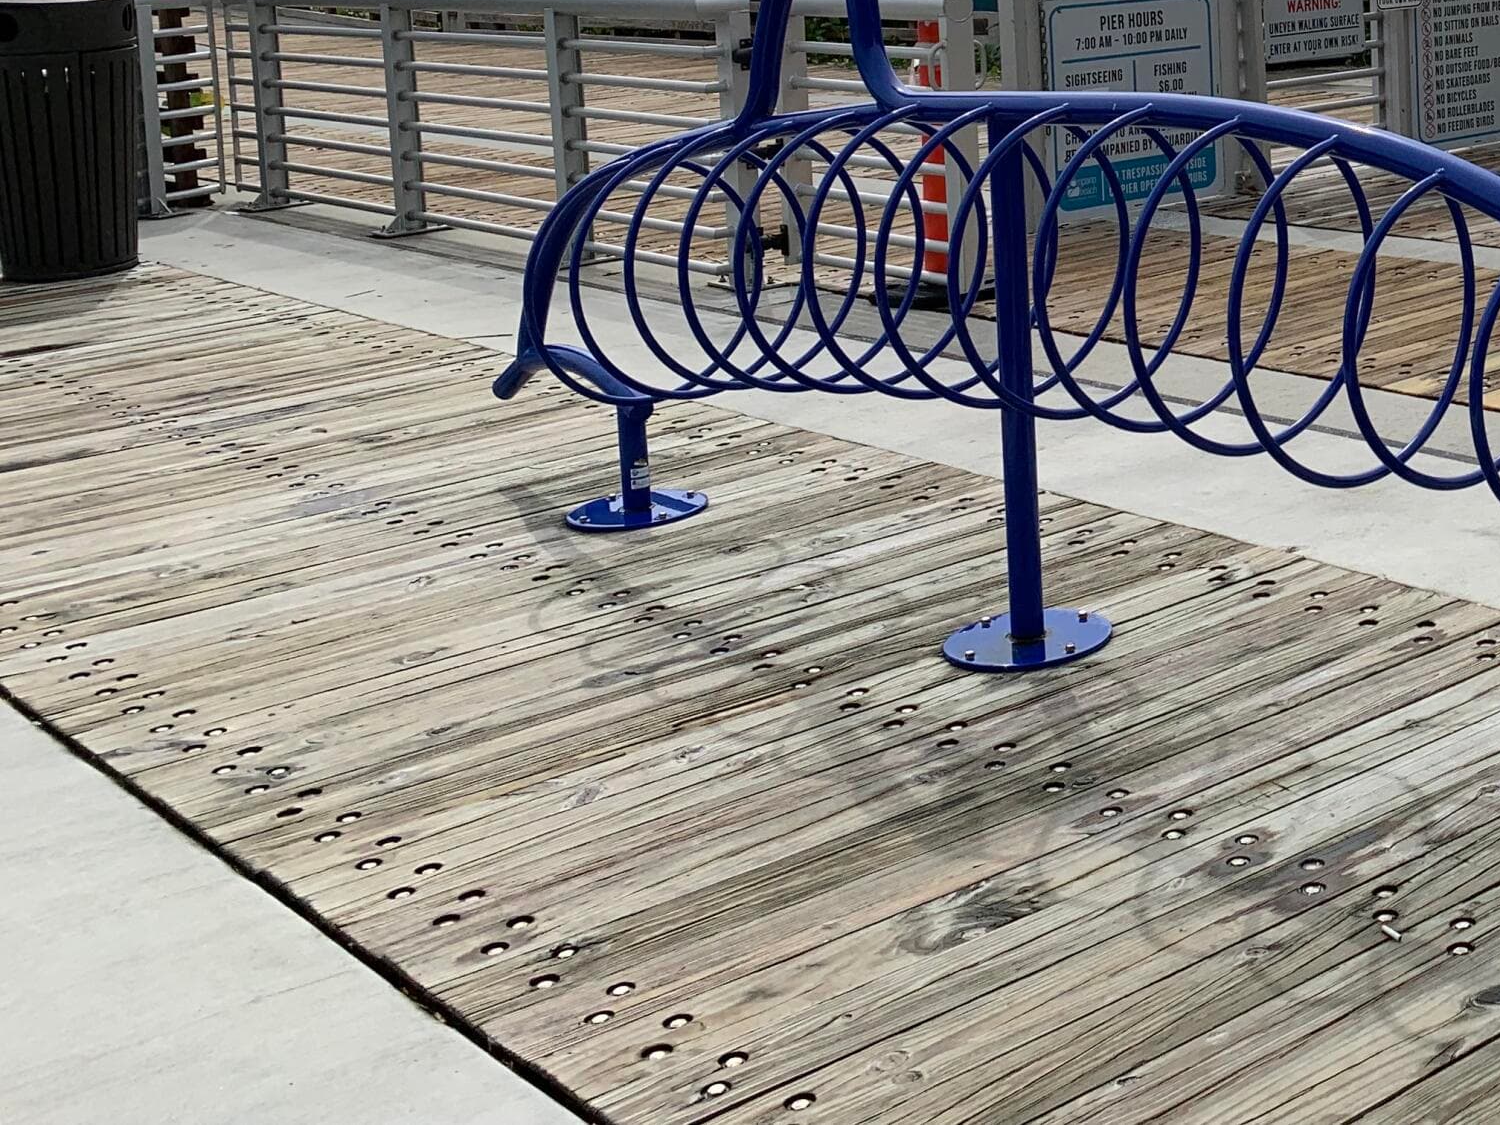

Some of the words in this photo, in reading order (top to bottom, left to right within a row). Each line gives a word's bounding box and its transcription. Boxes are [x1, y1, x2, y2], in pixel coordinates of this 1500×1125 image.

[1433, 7, 1442, 18] NO
[1444, 3, 1471, 16] JUMPING
[1473, 2, 1490, 13] FROM
[1100, 14, 1125, 32] PIER
[1128, 10, 1164, 29] HOURS
[1269, 21, 1297, 34] UNEVEN
[1298, 17, 1328, 31] WALKING
[1330, 13, 1360, 28] SURFACE
[1433, 21, 1442, 32] NO
[1444, 18, 1469, 31] SITTING
[1471, 17, 1480, 29] ON
[1481, 15, 1499, 27] RAILS
[1075, 37, 1096, 51] 7:00
[1099, 35, 1112, 48] AM
[1123, 31, 1147, 46] 10:00
[1150, 29, 1163, 43] PM
[1165, 27, 1188, 41] DAILY
[1270, 43, 1291, 56] ENTER
[1292, 41, 1301, 54] AT
[1304, 38, 1322, 52] YOUR
[1324, 36, 1339, 49] OWN
[1341, 34, 1359, 47] RISK!
[1434, 36, 1443, 47] NO
[1445, 32, 1473, 46] ANIMALS
[1434, 50, 1443, 62] NO
[1445, 48, 1462, 60] BARE
[1464, 46, 1479, 57] FEET
[1154, 61, 1187, 77] FISHING
[1435, 65, 1444, 76] NO
[1446, 61, 1472, 74] OUTSIDE
[1065, 68, 1123, 88] SIGHTSEEING
[1159, 79, 1184, 93] $6.00
[1435, 80, 1445, 91] NO
[1446, 73, 1491, 89] SKATEBOARDS
[1436, 94, 1445, 105] NO
[1447, 90, 1477, 103] BICYCLES
[1436, 108, 1446, 119] NO
[1447, 101, 1495, 118] ROLLERBLADES
[1437, 123, 1446, 134] NO
[1447, 118, 1475, 132] FEEDING
[1476, 115, 1495, 127] BIRDS
